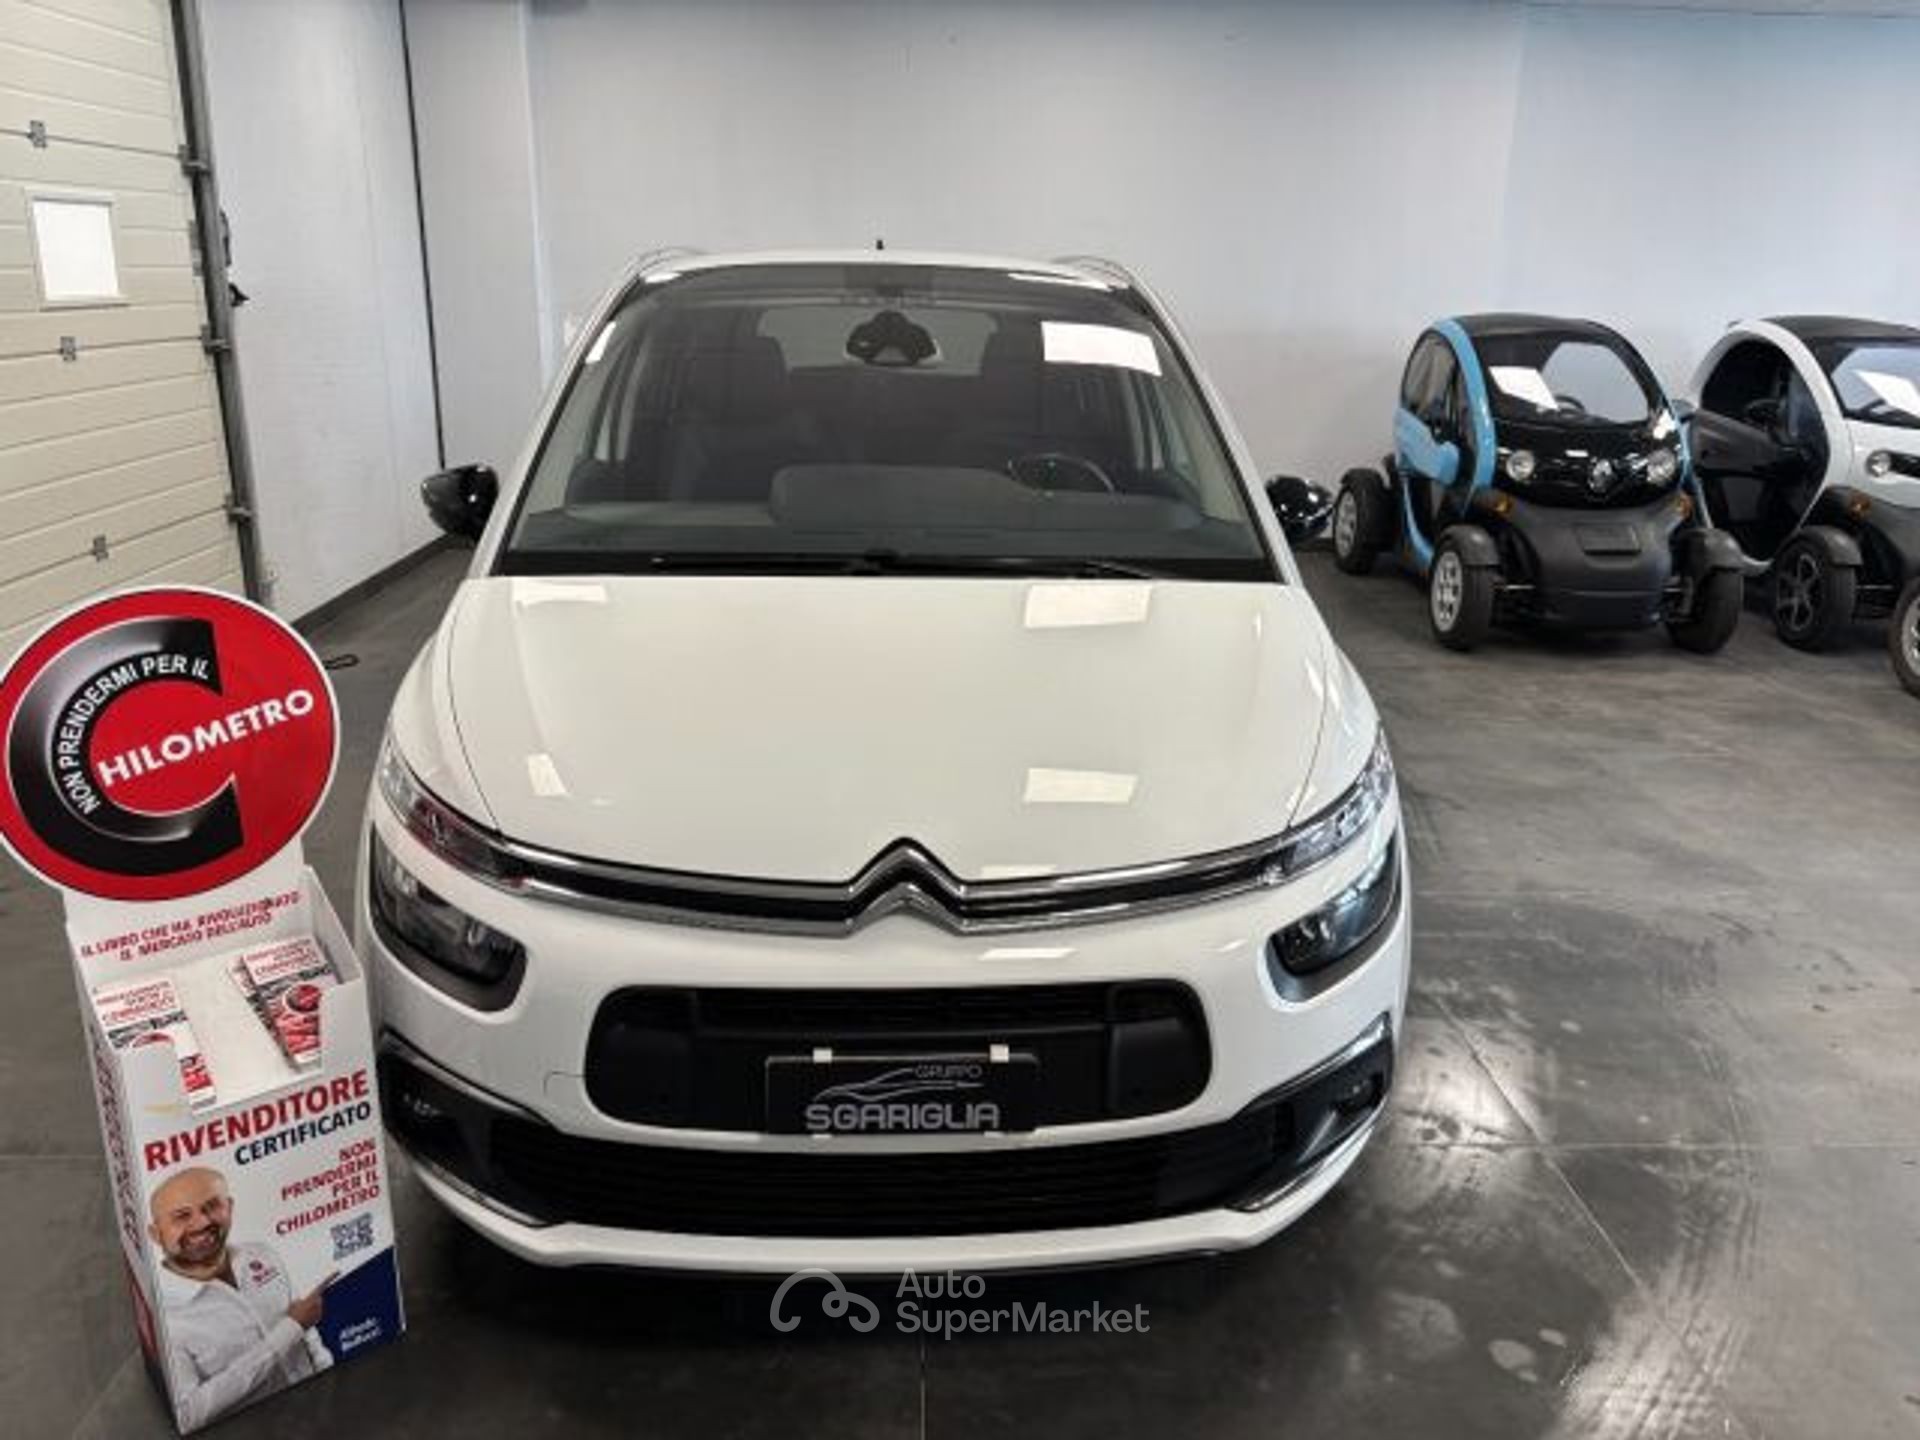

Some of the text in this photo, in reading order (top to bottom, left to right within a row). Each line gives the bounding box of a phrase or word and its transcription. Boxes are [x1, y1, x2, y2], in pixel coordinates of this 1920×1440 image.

[57, 653, 209, 815] NON PRENDERMI PER IL
[914, 1064, 983, 1079] GRUPPO
[144, 1069, 370, 1171] RIVENDITORE
[234, 1101, 371, 1166] CERTIFICATO
[805, 1103, 1000, 1130] SGARIGLIA
[339, 1138, 376, 1161] NON
[281, 1152, 377, 1201] PRENDERMI
[332, 1170, 379, 1197] PER IL
[275, 1184, 380, 1235] CHILOMETRO
